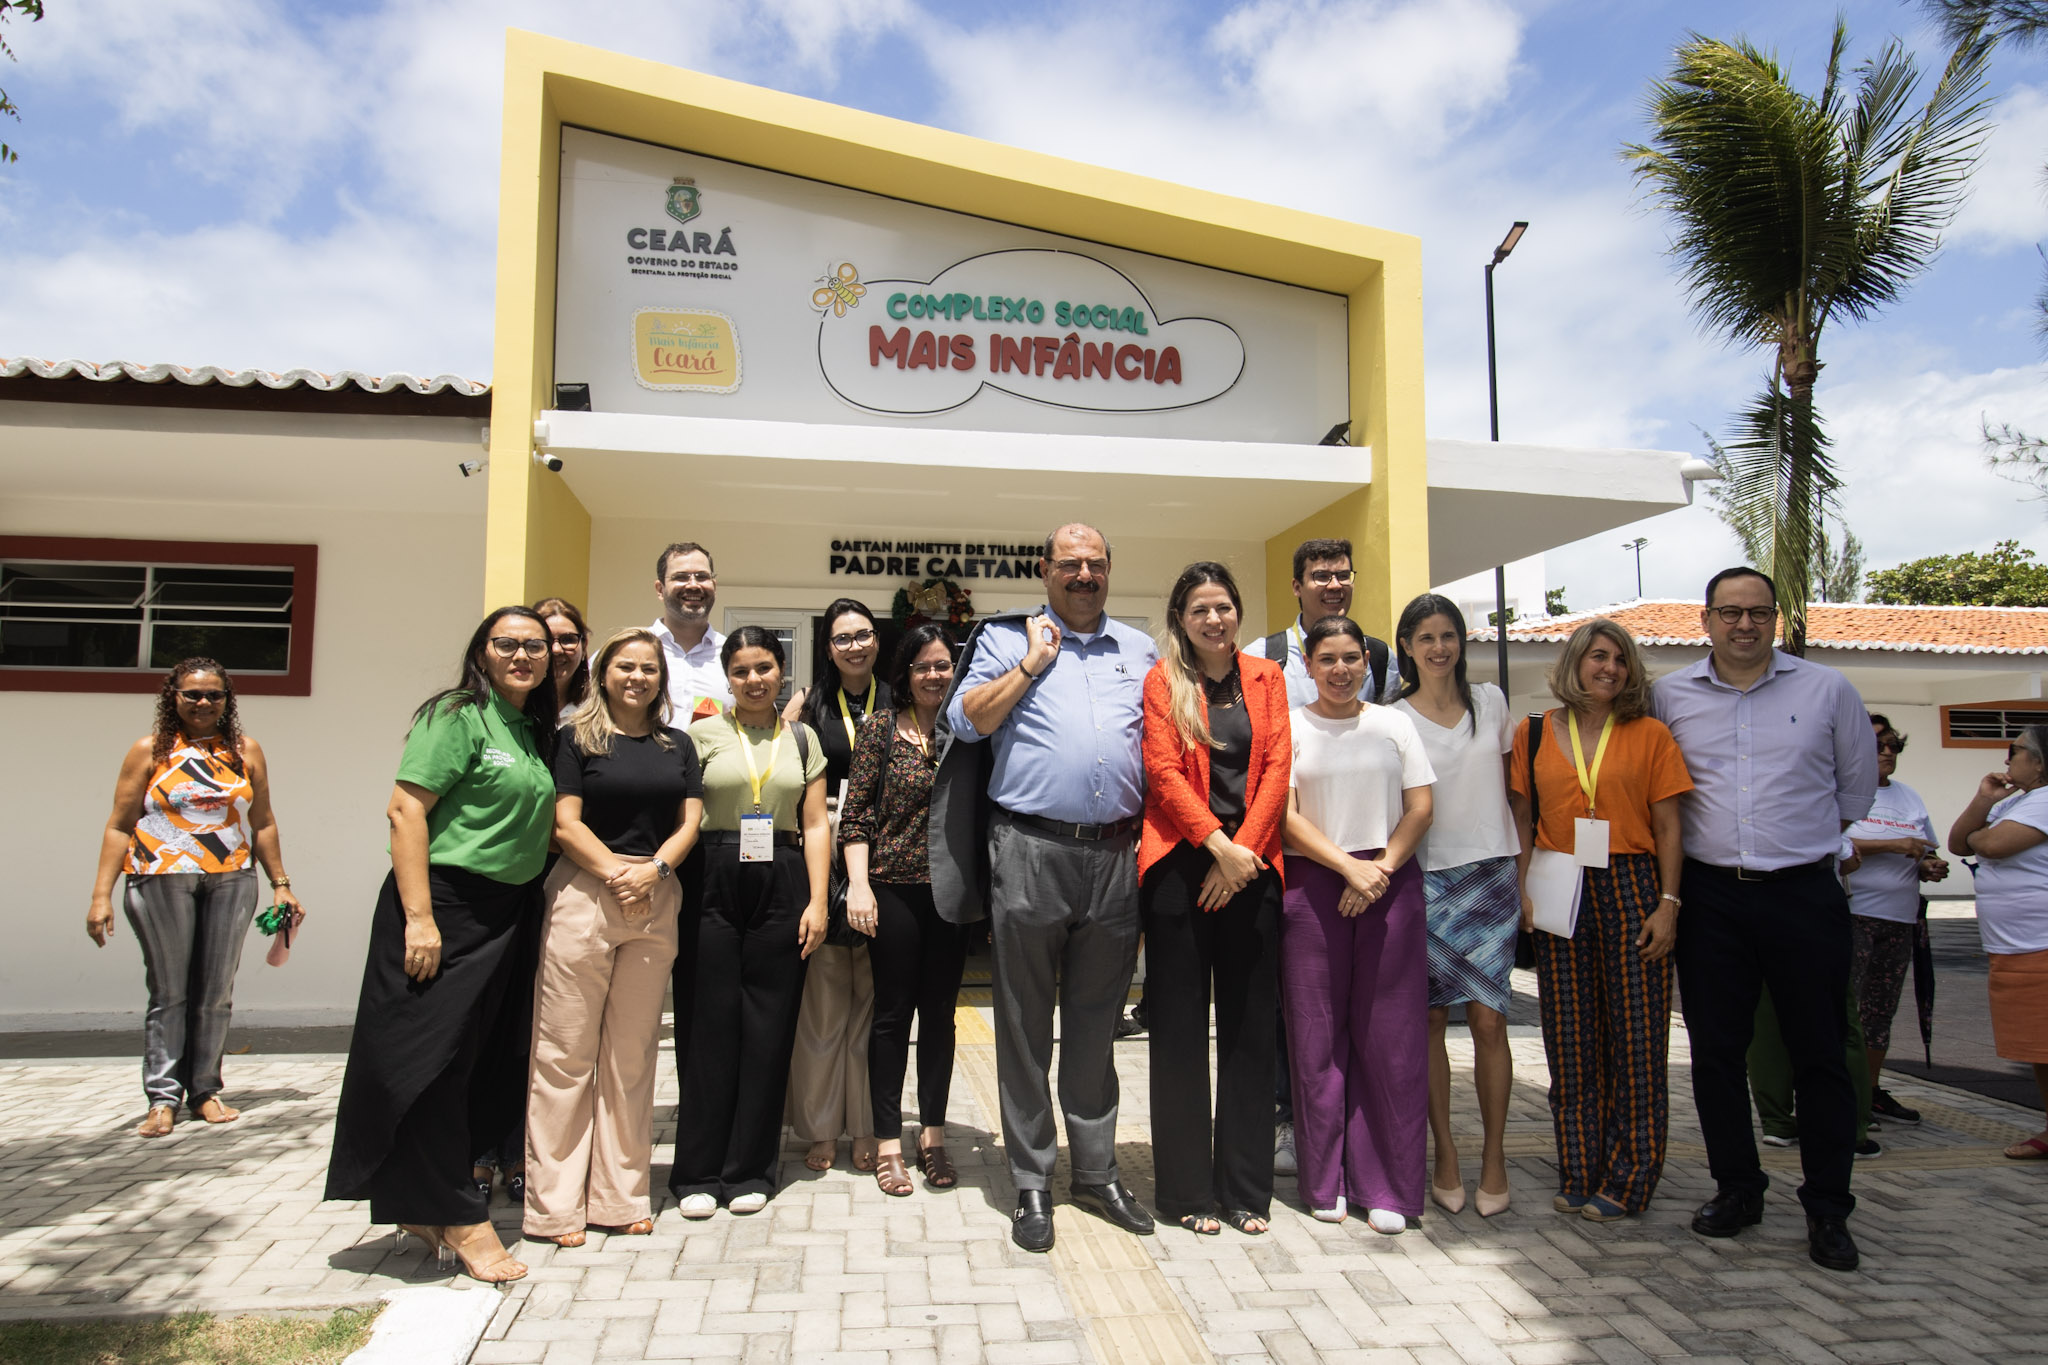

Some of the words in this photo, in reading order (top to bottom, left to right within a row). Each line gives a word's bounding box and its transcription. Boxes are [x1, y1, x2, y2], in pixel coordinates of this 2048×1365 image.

[627, 226, 737, 256] CEARÁ
[627, 256, 678, 268] GOVERNO
[681, 259, 696, 268] DO
[699, 261, 738, 271] ESTADO
[631, 268, 666, 277] SECRETARIA
[677, 271, 709, 279] PROTEÇÃO
[887, 293, 1045, 324] COMPLEXO
[1055, 301, 1148, 336] SOCIAL
[654, 347, 716, 371] Ceará
[869, 325, 976, 371] MAIS
[990, 332, 1182, 385] INFÂNCIA
[830, 540, 892, 553] GAETAN
[896, 541, 961, 555] MINETTE
[965, 544, 985, 555] DE
[830, 556, 919, 576] PADRE
